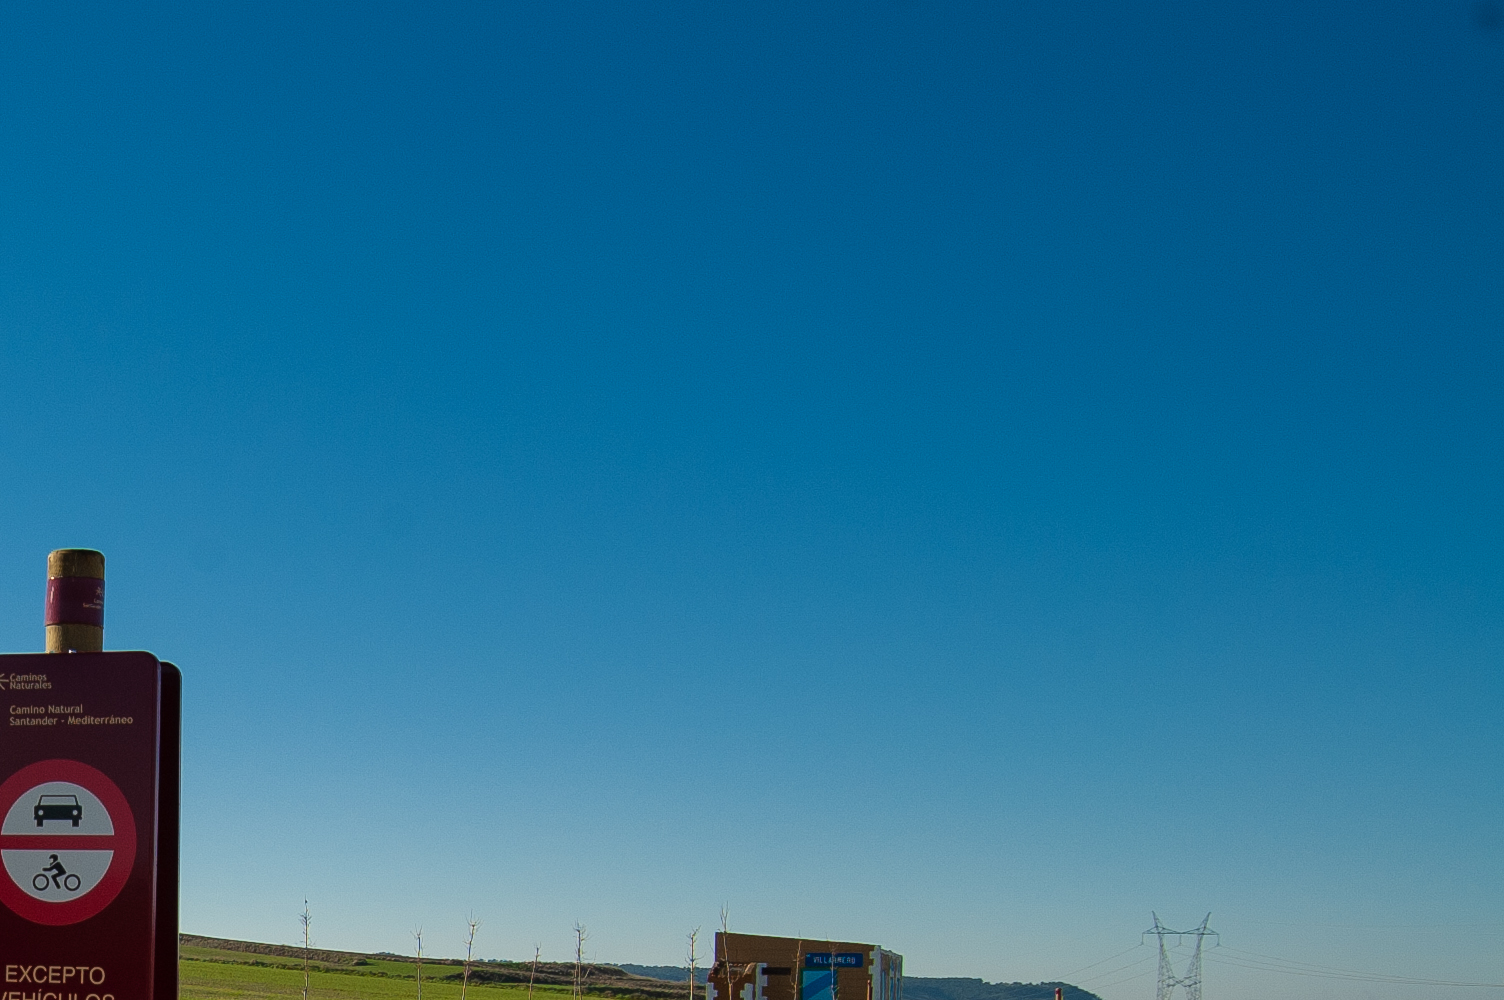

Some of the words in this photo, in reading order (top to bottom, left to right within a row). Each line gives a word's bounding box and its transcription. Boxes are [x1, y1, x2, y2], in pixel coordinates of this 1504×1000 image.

[9, 672, 47, 684] Caminos
[9, 681, 53, 690] Naturales
[10, 705, 45, 714] Camino
[48, 704, 82, 713] Natural
[10, 716, 57, 725] Santander
[68, 715, 133, 724] Mediterráneo
[6, 965, 105, 984] EXCEPTO
